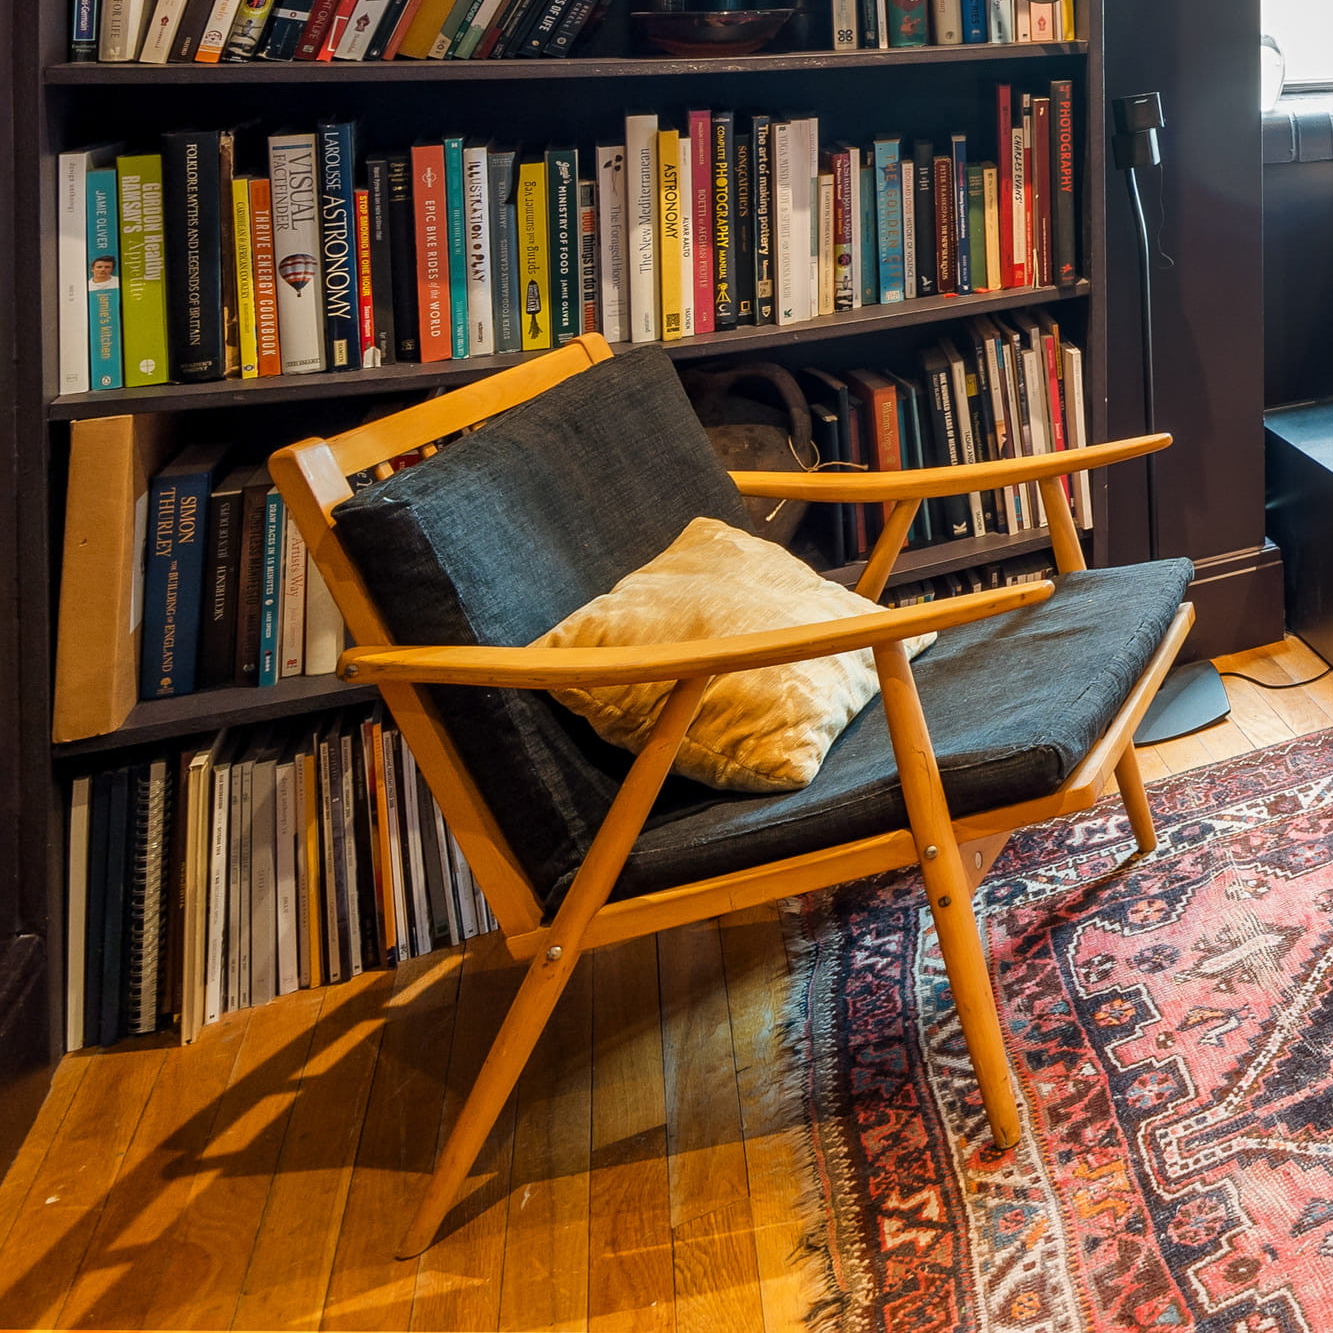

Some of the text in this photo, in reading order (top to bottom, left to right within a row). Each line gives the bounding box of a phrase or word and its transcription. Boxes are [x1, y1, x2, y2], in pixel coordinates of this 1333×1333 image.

[539, 16, 555, 32] LIFE
[549, 5, 562, 16] OF
[970, 4, 979, 26] RIES
[1059, 101, 1072, 192] PHOTOGRAPHY
[95, 192, 107, 249] JAMIE OLIVER
[273, 154, 290, 232] FACTFINDER
[288, 152, 315, 230] VISUAL
[323, 132, 351, 318] LAROUSSE ASTRONOMY
[425, 200, 435, 222] EPIC
[558, 186, 568, 230] MINISTRY
[639, 148, 652, 274] The New Mediterranean
[664, 164, 679, 238] ASTRONOMY
[715, 125, 729, 279] COMPLETE PHOTOGRAPHY MANUAL
[758, 125, 769, 255] The art of making pottery
[121, 175, 145, 301] RAMSAY'S Appetite
[142, 182, 163, 281] GORDON Healthy
[186, 144, 200, 345] FOLKLORE MYTHS AND LEGENDS OF BRITAIN
[359, 195, 371, 296] STOP SMOKING IN ONE HOUR
[426, 226, 437, 246] BIKE
[427, 250, 438, 280] RIDES
[559, 232, 568, 244] OF
[559, 246, 568, 274] FOOD
[255, 210, 275, 356] THRIVE ENERGY COOKBOOK
[429, 301, 441, 337] WORLD
[156, 488, 176, 557] THURLEY
[178, 497, 197, 544] SIMON
